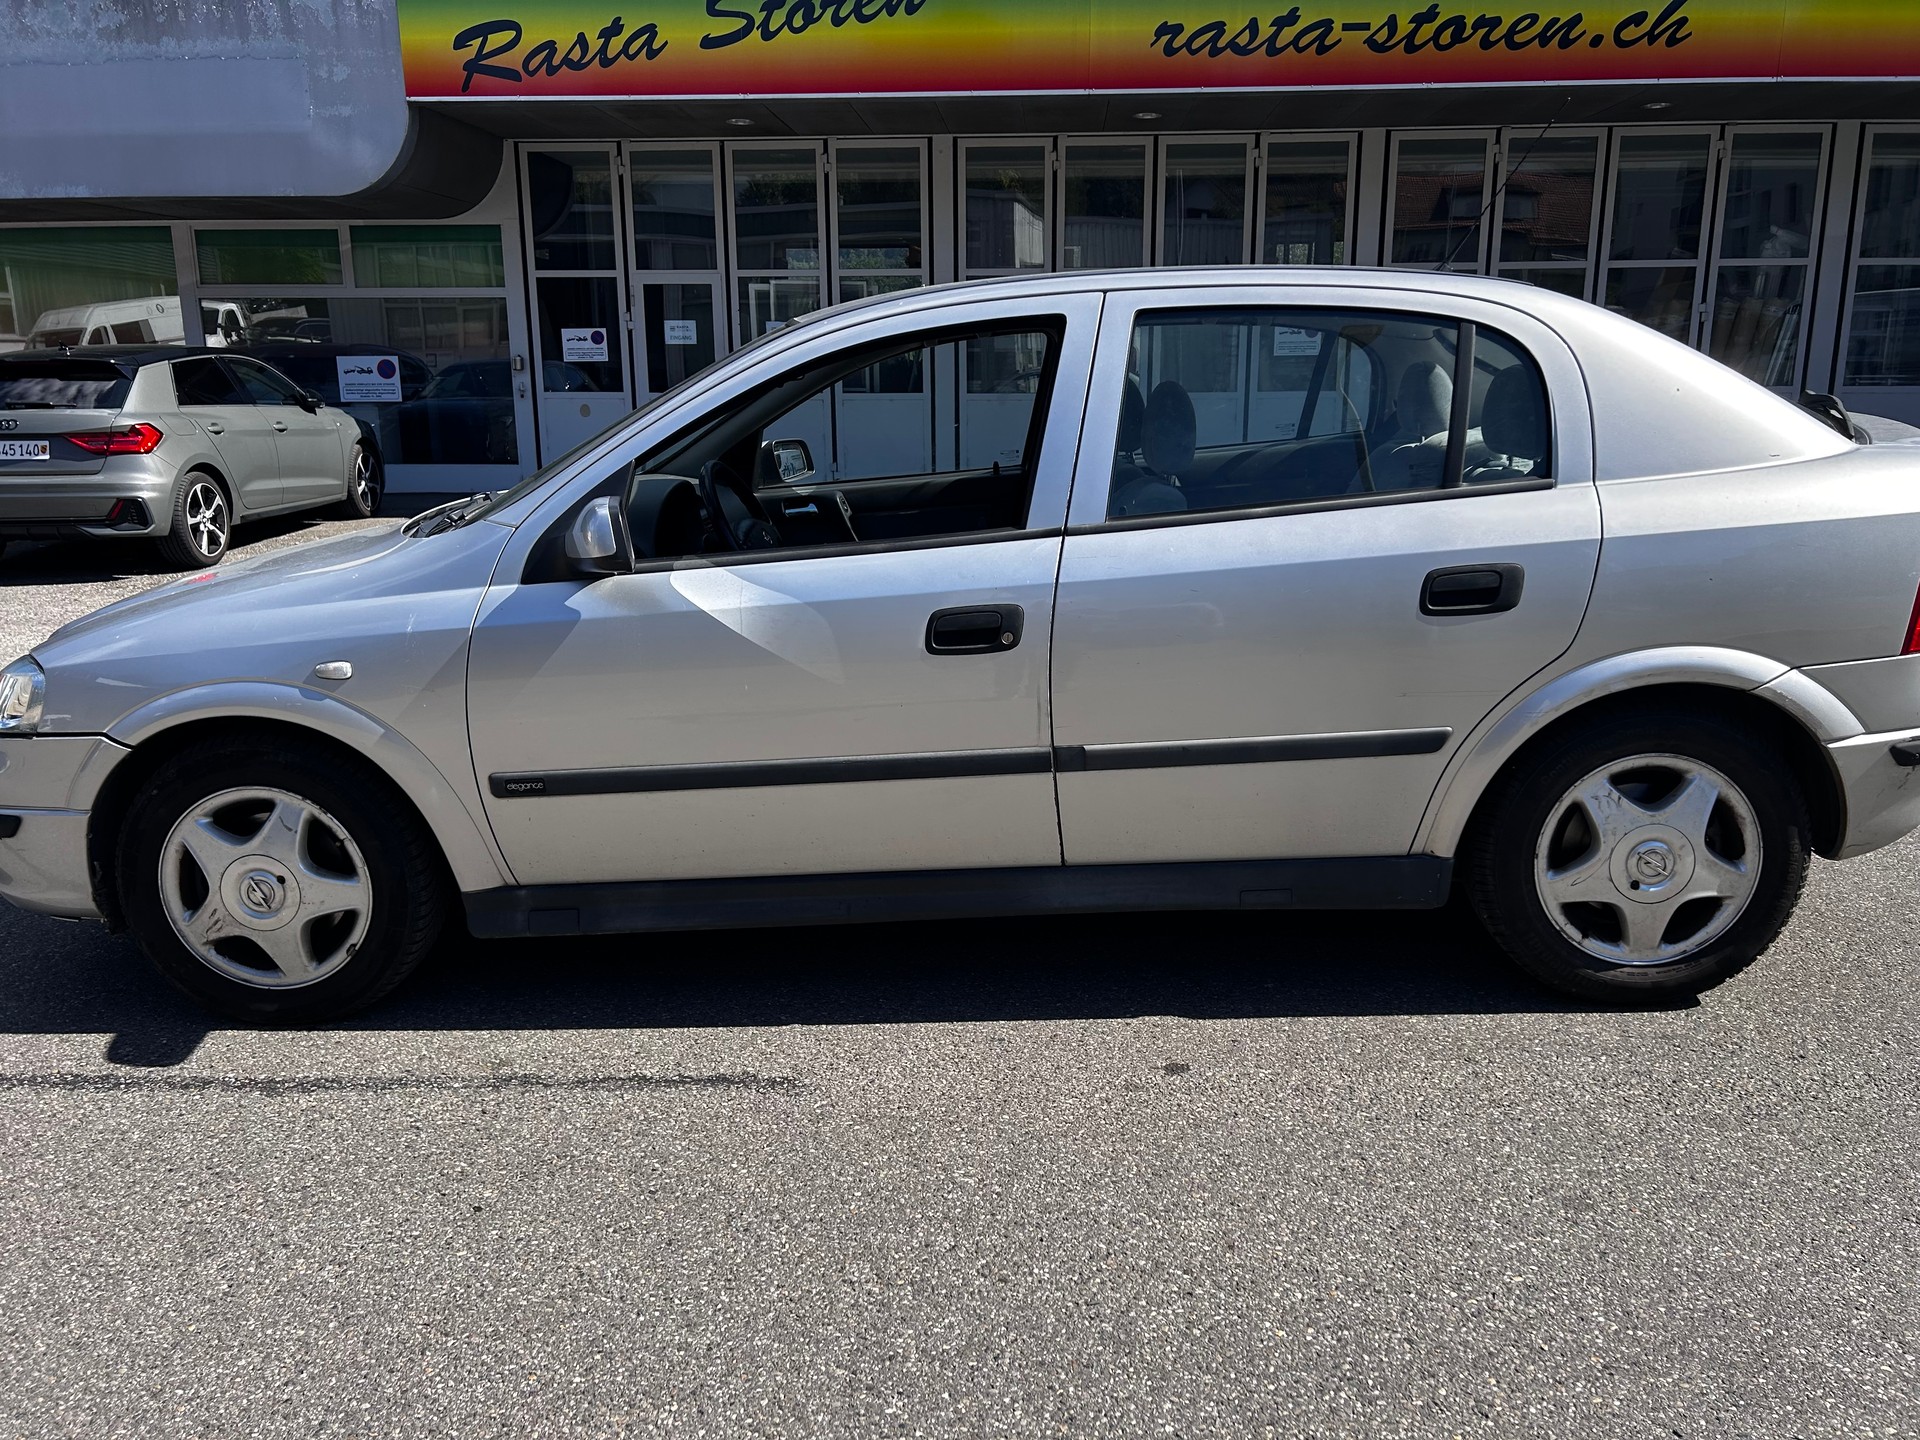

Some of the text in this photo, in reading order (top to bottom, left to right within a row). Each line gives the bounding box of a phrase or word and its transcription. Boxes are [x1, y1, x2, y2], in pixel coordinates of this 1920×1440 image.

[1149, 0, 1693, 59] rasta-storen.ch
[452, 16, 669, 93] Rasta
[18, 443, 40, 457] 140
[507, 780, 544, 792] elegance
